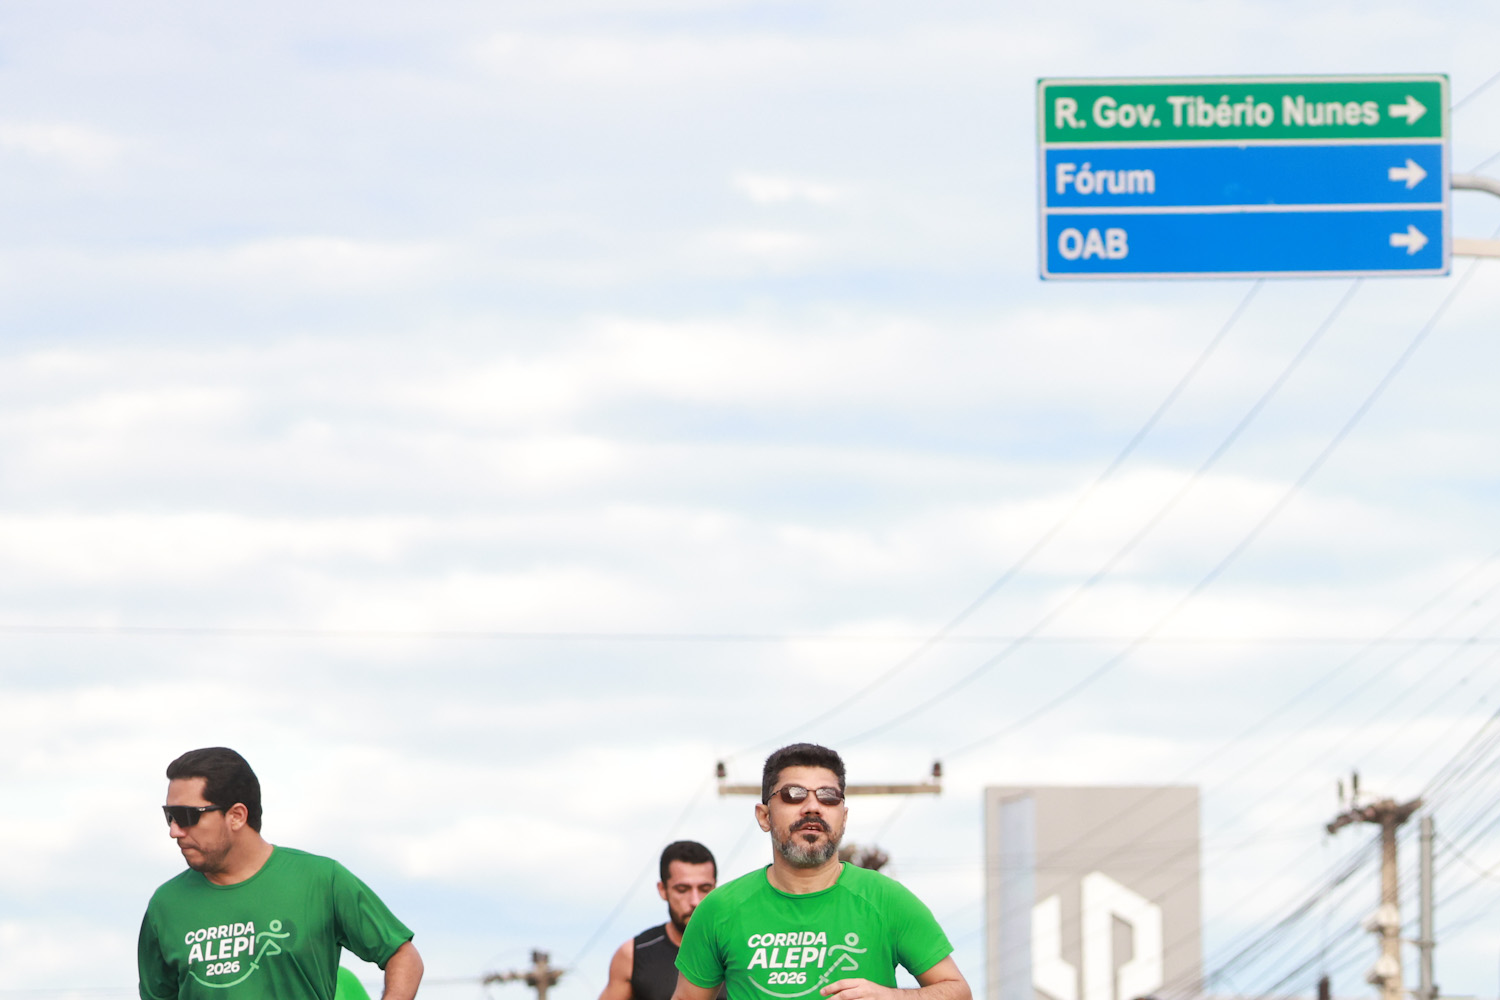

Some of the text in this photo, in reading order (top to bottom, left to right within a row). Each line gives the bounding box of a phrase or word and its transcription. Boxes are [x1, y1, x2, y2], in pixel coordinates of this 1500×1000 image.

[1054, 94, 1380, 128] R. Gov. Tibério Nunes
[1055, 162, 1156, 195] Fórum
[1057, 228, 1129, 260] OAB
[185, 921, 255, 945] CORRIDA
[747, 931, 827, 948] CORRIDA
[188, 935, 255, 965] ALEPI
[747, 947, 827, 970] ALEPI
[206, 961, 240, 976] 2026
[767, 971, 807, 985] 2026
